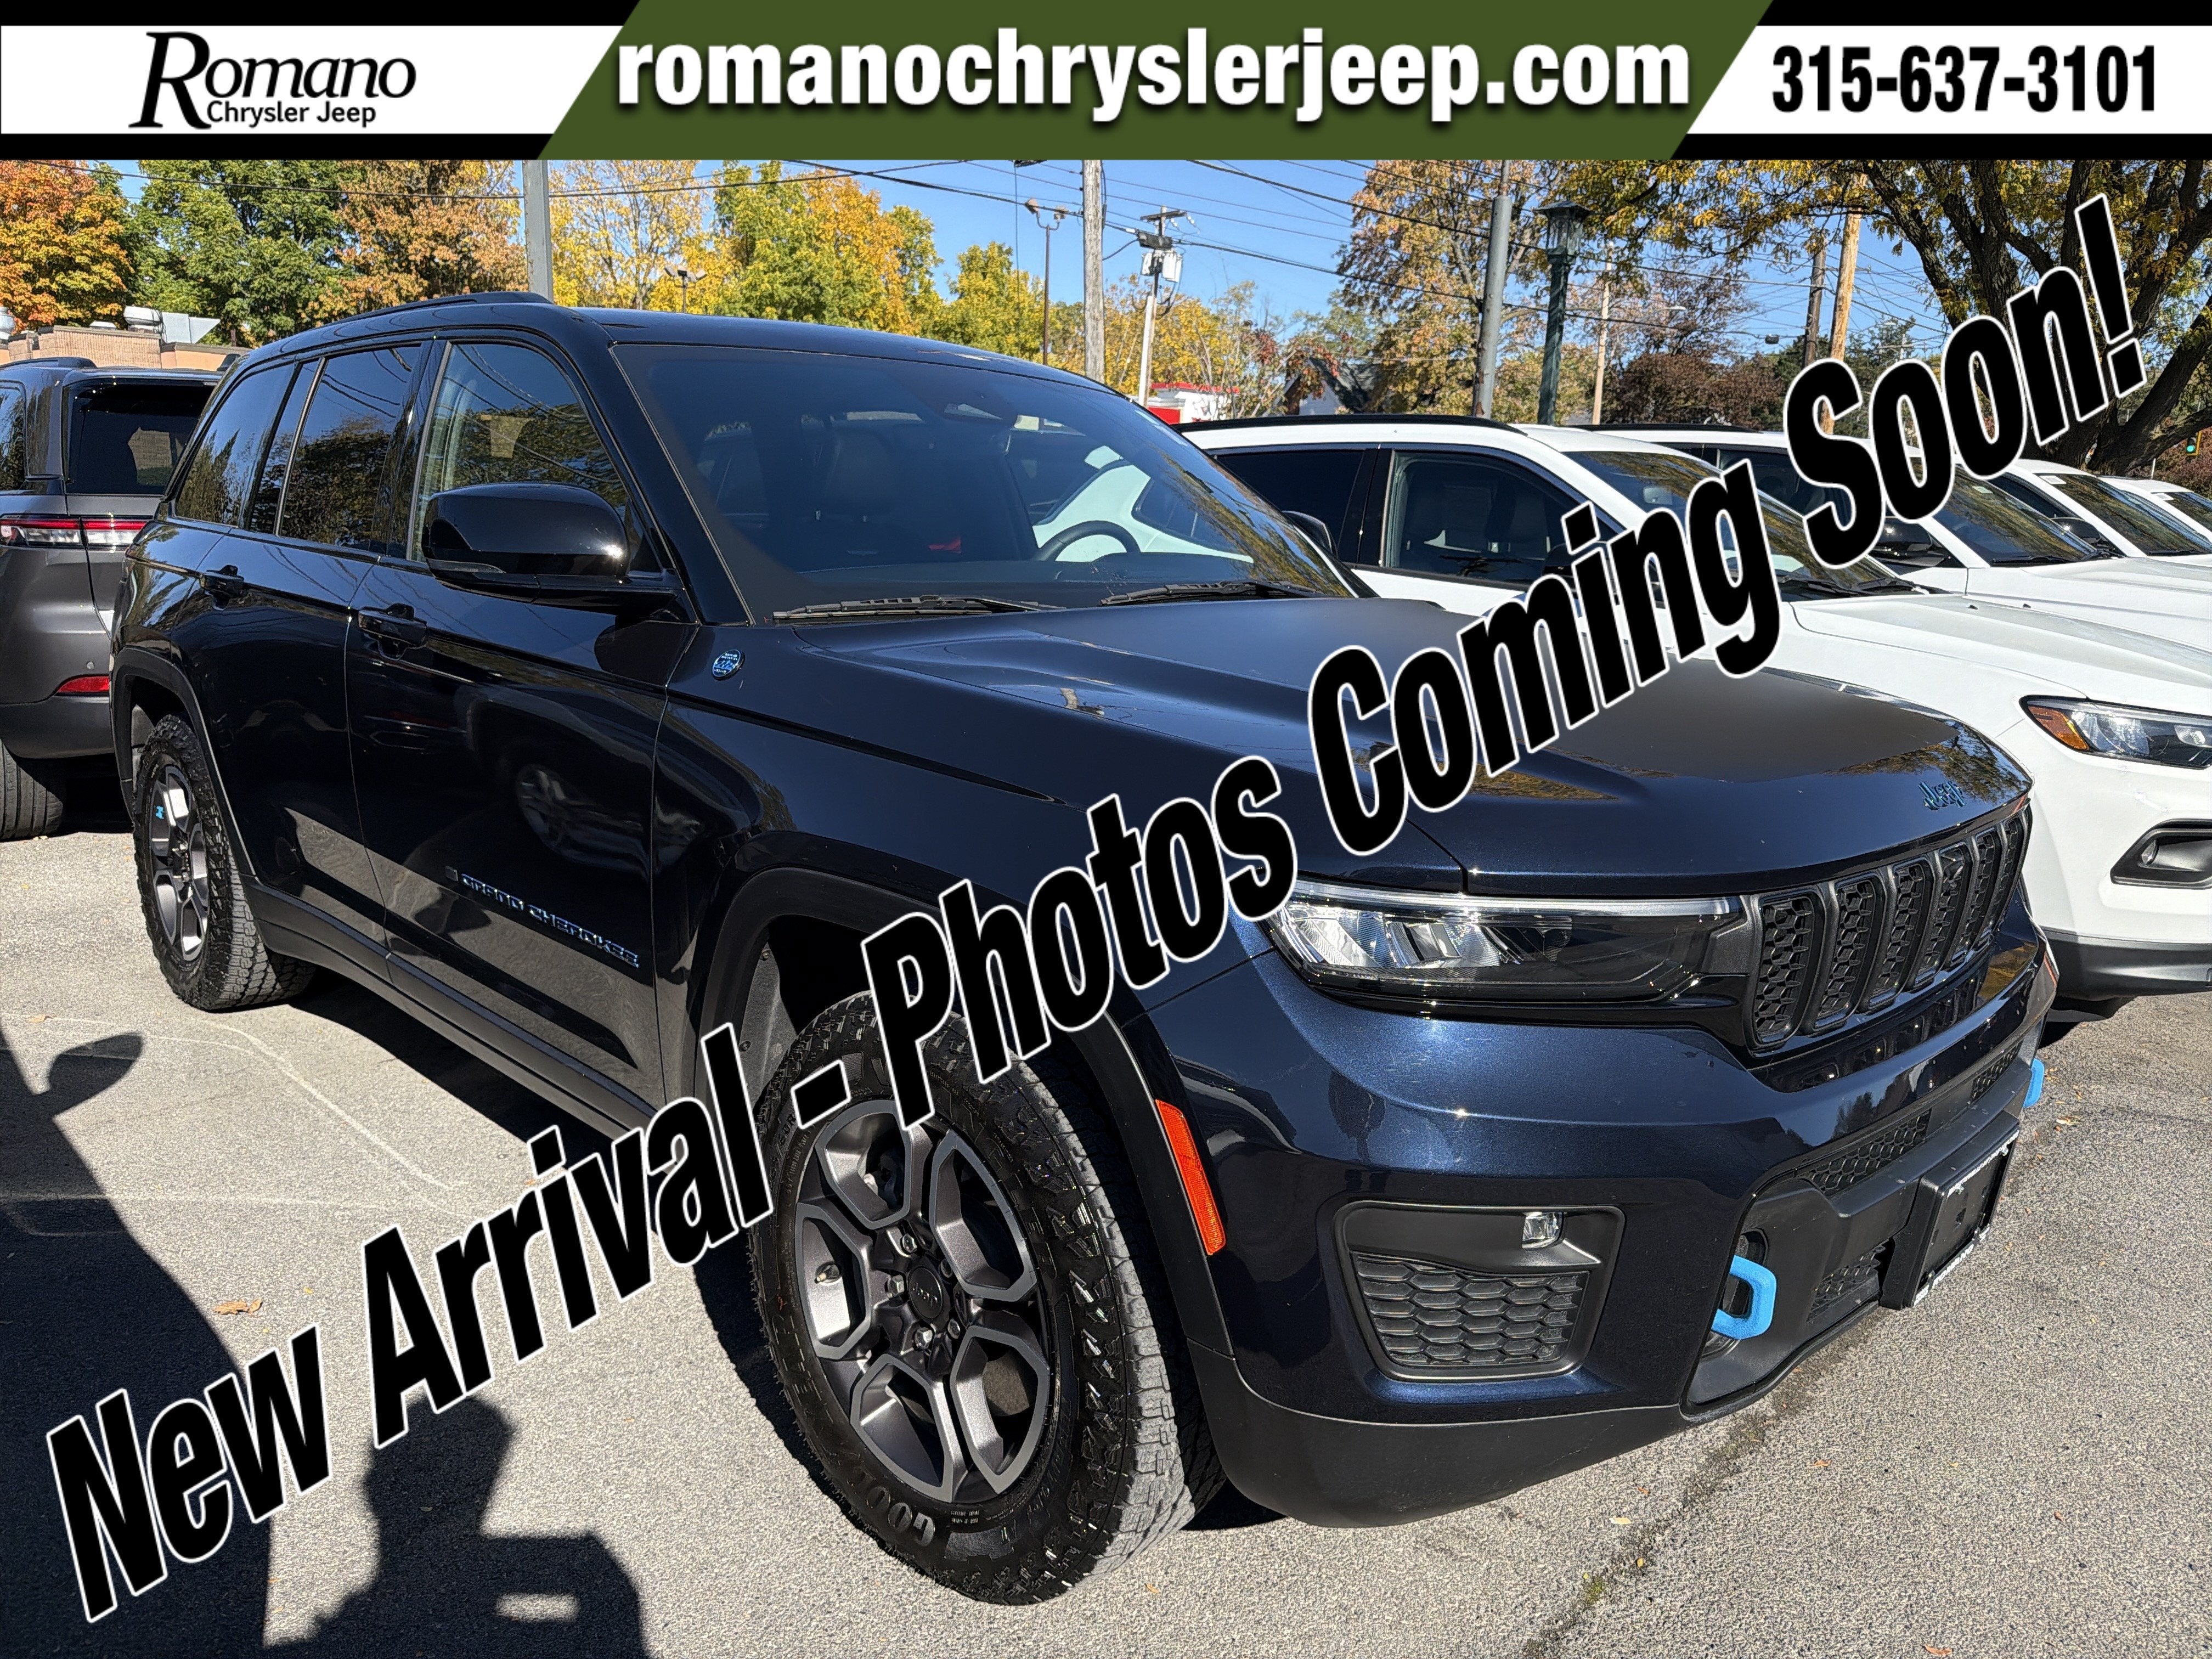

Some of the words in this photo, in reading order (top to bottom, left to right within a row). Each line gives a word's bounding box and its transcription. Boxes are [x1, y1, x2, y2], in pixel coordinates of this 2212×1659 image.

[1918, 781, 1966, 810] Jeep
[461, 873, 523, 911] GRAND
[528, 905, 639, 968] CHEROKEE
[872, 1057, 1058, 1279] WANGLER
